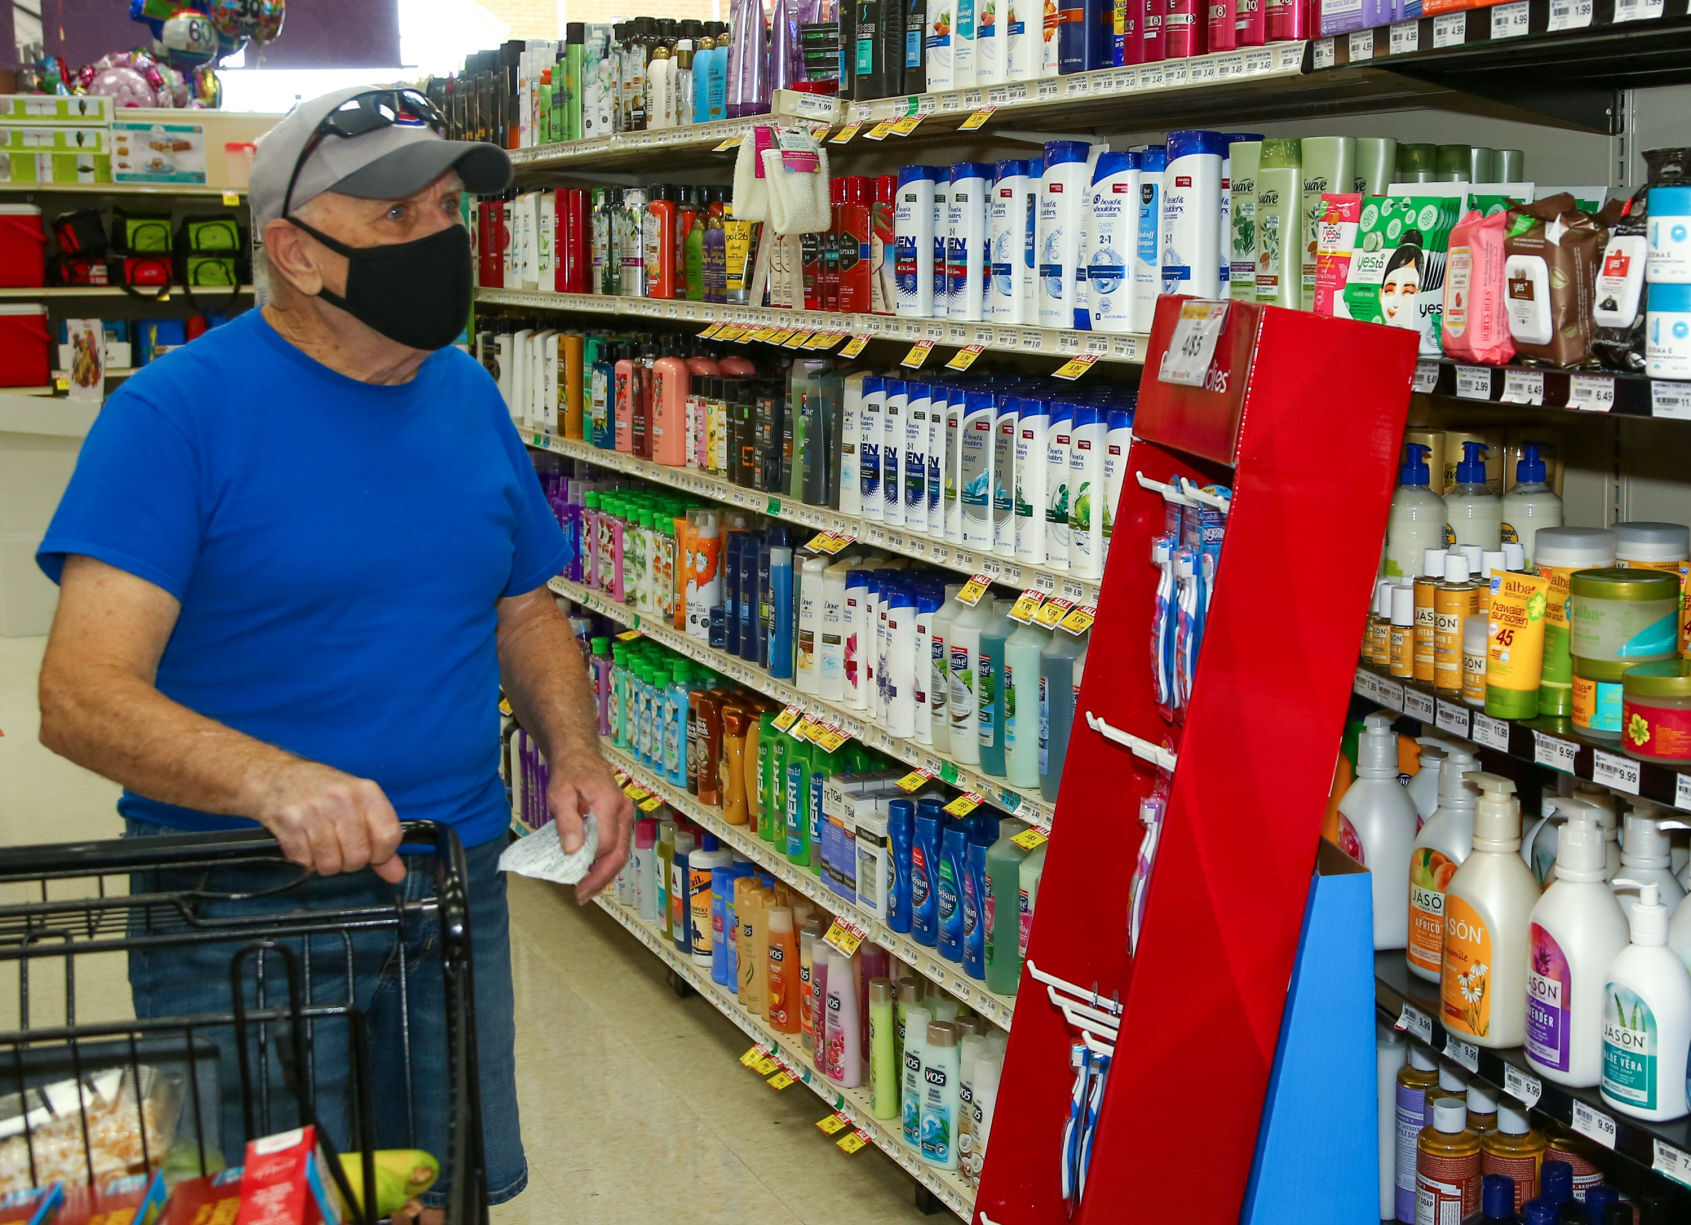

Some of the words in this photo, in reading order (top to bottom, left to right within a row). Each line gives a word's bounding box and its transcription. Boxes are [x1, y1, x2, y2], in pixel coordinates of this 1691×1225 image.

[1575, 4, 1591, 16] 1.99
[1514, 14, 1528, 25] 4.99
[188, 20, 214, 44] 60
[1406, 32, 1417, 41] 4.99
[1451, 25, 1464, 35] 4.99
[818, 103, 832, 111] 1.99
[1231, 177, 1254, 192] Suave
[1304, 177, 1328, 192] Suave
[1358, 255, 1376, 271] yes
[1375, 260, 1384, 268] to
[1420, 304, 1443, 317] yes
[1475, 381, 1488, 392] 2.99
[1528, 384, 1543, 395] 6.49
[1596, 390, 1613, 401] 6.49
[973, 574, 989, 584] SALE
[1505, 581, 1531, 594] alba
[1027, 590, 1042, 600] SALE
[1052, 598, 1070, 608] SALE
[1496, 628, 1514, 646] 45
[1420, 702, 1432, 714] 7.99
[1454, 715, 1468, 728] 12.49
[1494, 726, 1508, 738] 11.99
[1558, 746, 1574, 760] 9.99
[1619, 768, 1637, 783] 9.99
[787, 776, 797, 828] PERT
[810, 784, 818, 836] PERT
[1416, 918, 1440, 934] APRICO
[1464, 1046, 1477, 1061] 9.99
[905, 1054, 919, 1068] VO5
[1620, 1057, 1642, 1072] VERA
[926, 1071, 944, 1084] VO5
[1526, 1084, 1540, 1098] 9.99
[1598, 1118, 1615, 1134] 9.99
